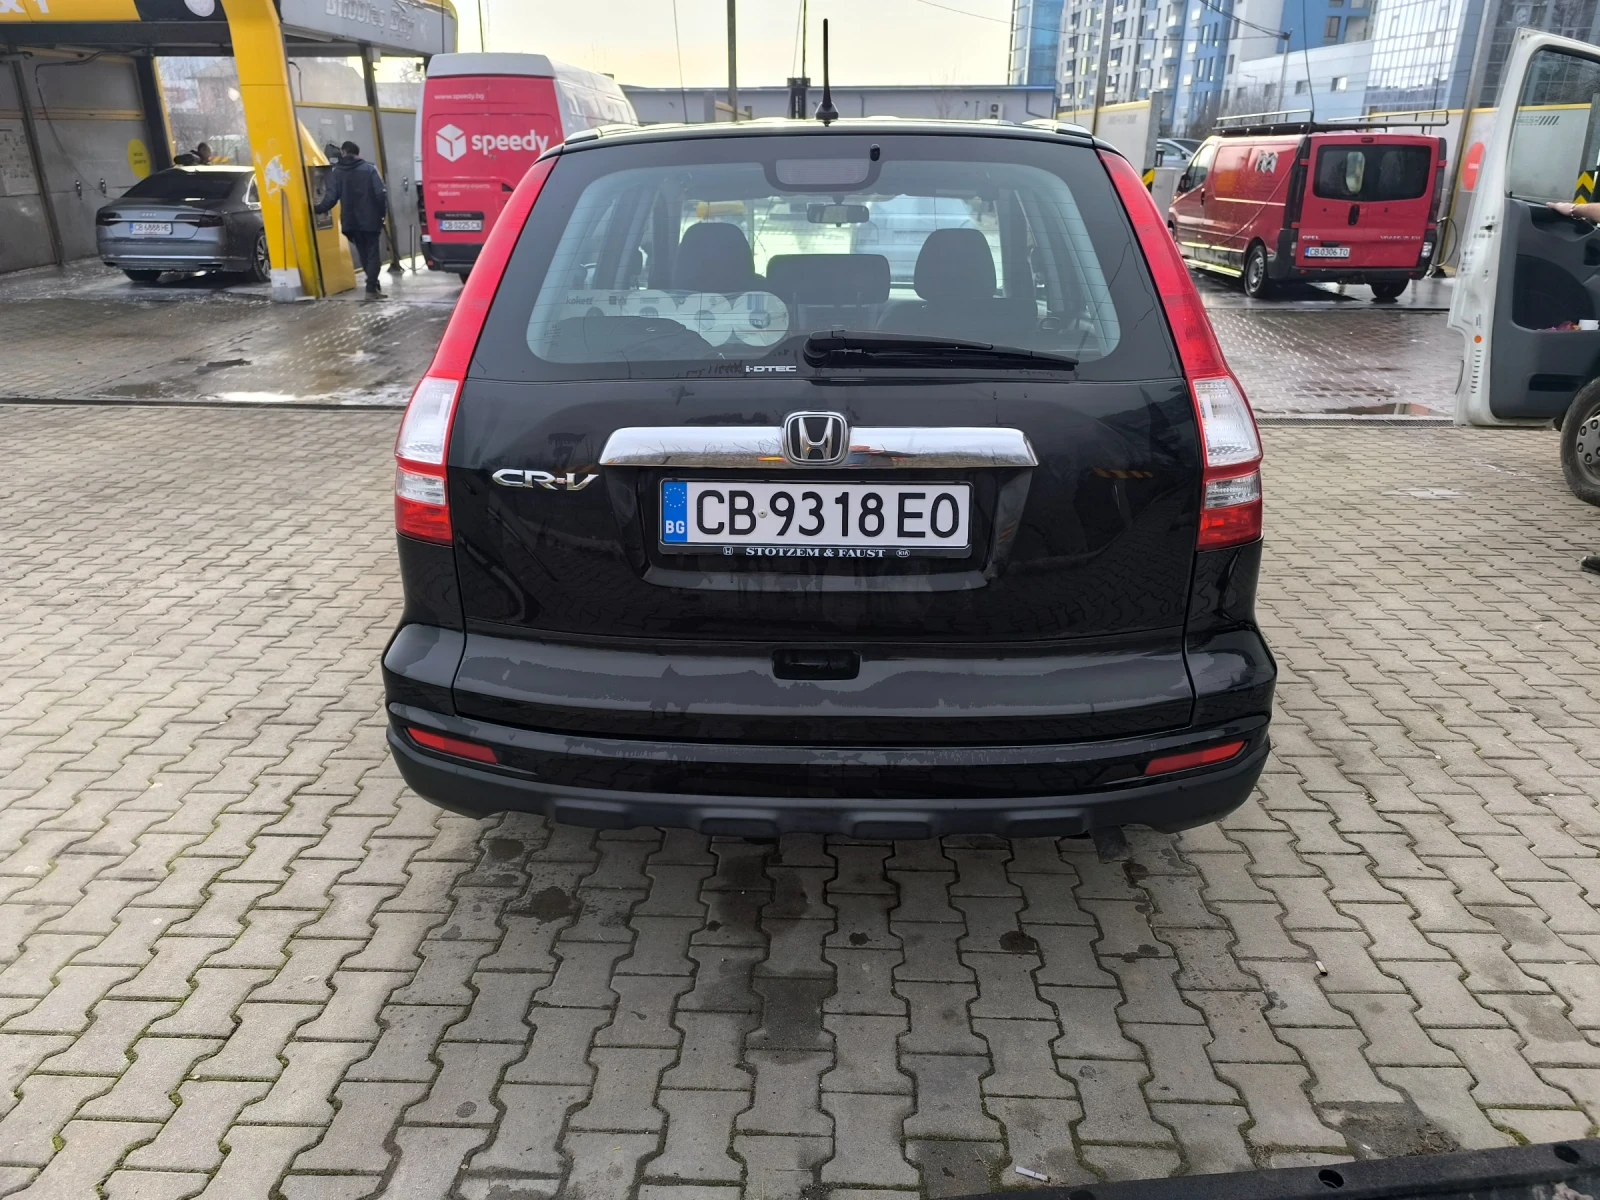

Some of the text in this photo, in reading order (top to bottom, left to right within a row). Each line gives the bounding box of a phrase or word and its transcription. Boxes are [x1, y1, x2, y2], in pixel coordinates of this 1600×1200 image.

[434, 93, 485, 101] www.speedy.bg
[471, 129, 549, 157] speedy
[1309, 248, 1320, 256] CB
[1320, 248, 1338, 257] 0306
[491, 468, 600, 491] CR-V
[665, 520, 685, 534] BG
[696, 489, 757, 536] CB
[769, 491, 885, 538] 9318
[745, 546, 820, 558] STOTZEM
[823, 547, 833, 557] &
[838, 547, 886, 558] FAUST
